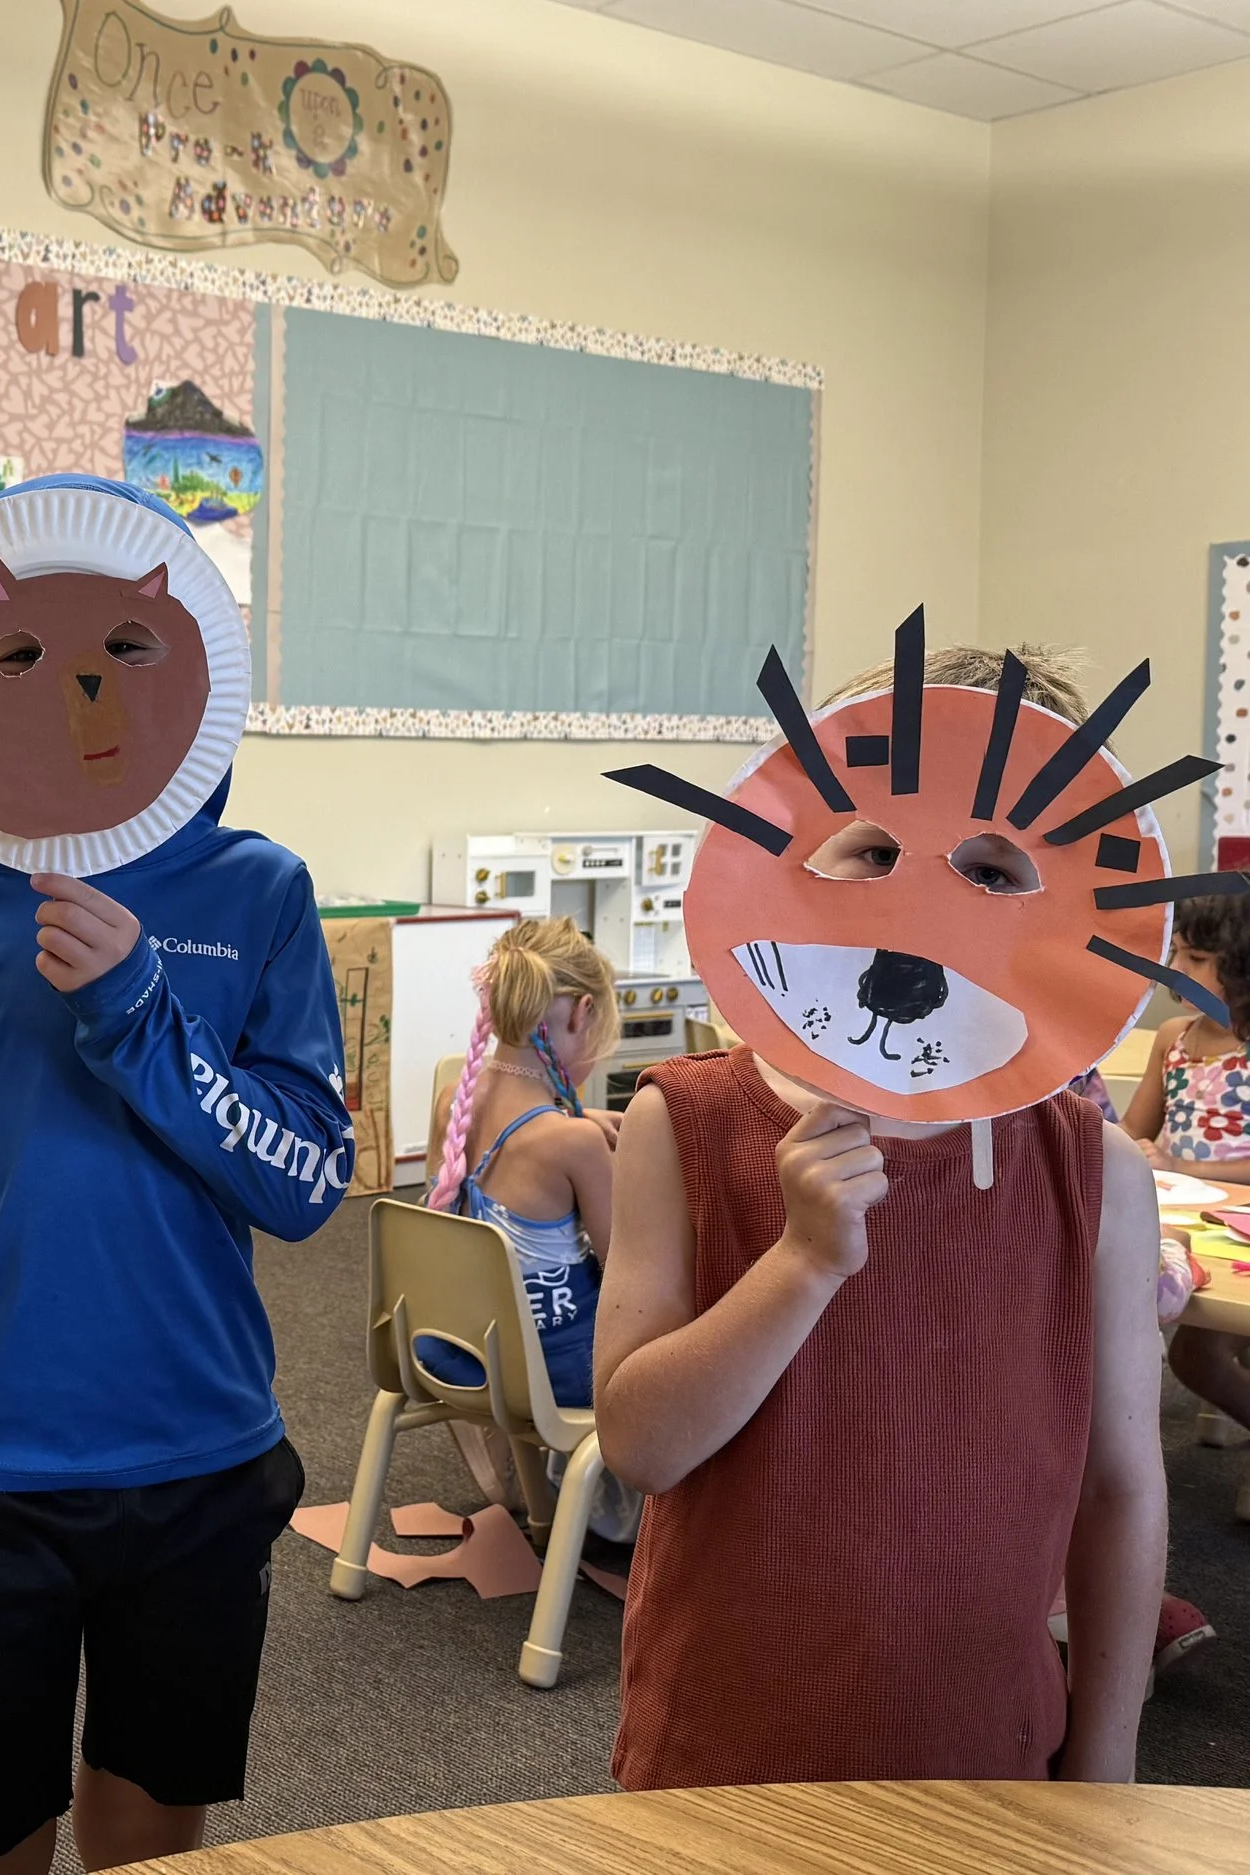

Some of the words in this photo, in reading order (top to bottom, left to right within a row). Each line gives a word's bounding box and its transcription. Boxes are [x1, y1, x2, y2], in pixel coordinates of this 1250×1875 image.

[94, 11, 220, 119] Once
[299, 88, 341, 120] upon
[15, 281, 138, 366] art
[162, 937, 239, 961] Columbia
[126, 955, 163, 1015] NI-SHADE
[190, 1052, 355, 1204] olumbia
[527, 1287, 577, 1318] ER
[536, 1308, 578, 1330] ARY
